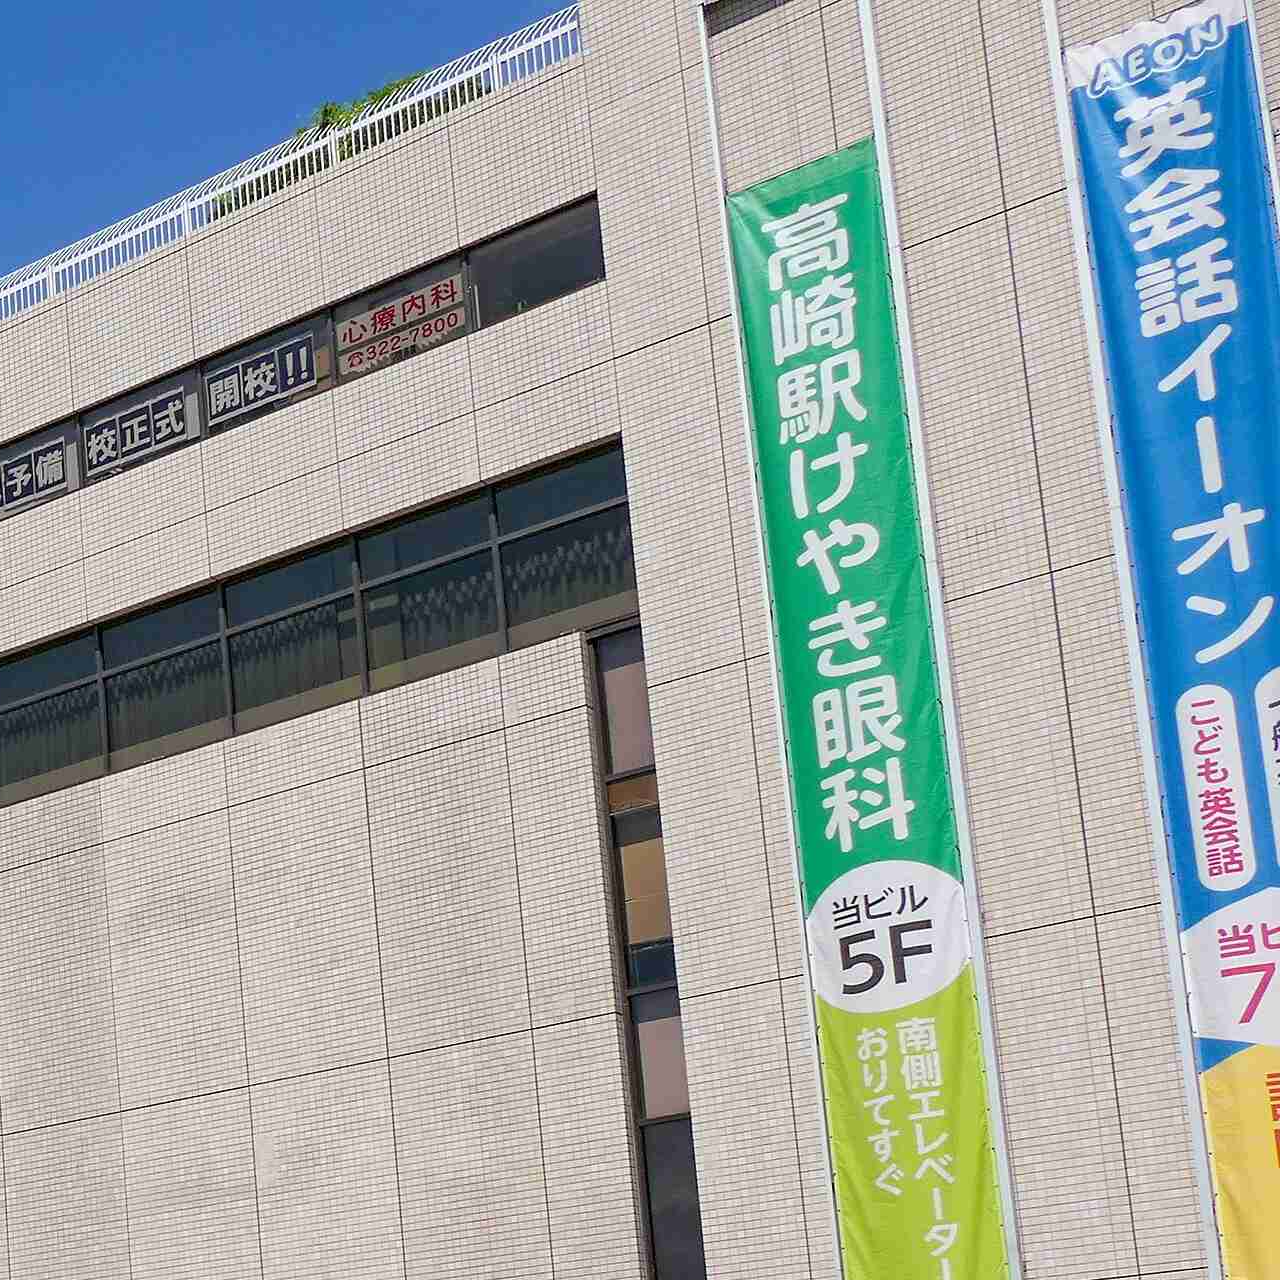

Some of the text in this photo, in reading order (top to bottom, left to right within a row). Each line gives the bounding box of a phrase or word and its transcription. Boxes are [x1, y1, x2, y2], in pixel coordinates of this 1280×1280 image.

[1087, 14, 1227, 97] AEON
[343, 280, 457, 343] 心療内科
[1114, 77, 1275, 663] 英会話イーオン
[760, 192, 918, 850] 高崎駅けやき眼科
[1189, 699, 1244, 877] こども英会話
[831, 885, 929, 927] 当ビル
[839, 918, 934, 997] 5F
[856, 1028, 905, 1198] おりてすぐ
